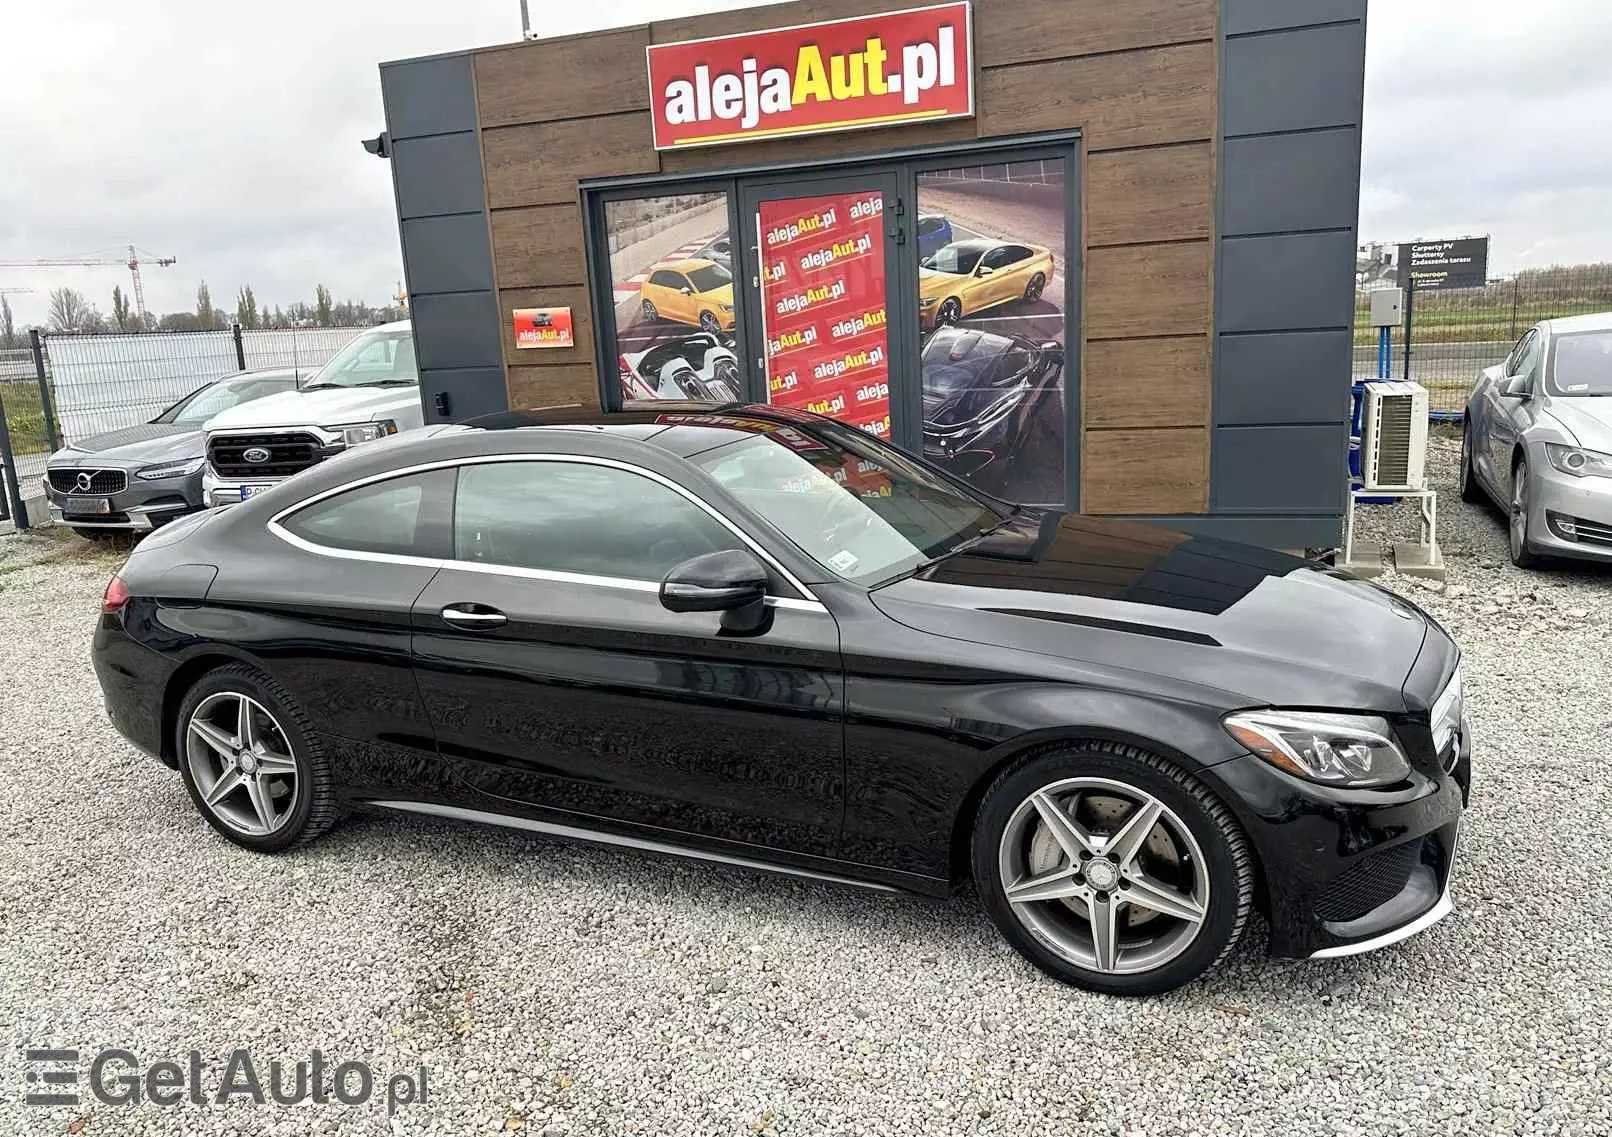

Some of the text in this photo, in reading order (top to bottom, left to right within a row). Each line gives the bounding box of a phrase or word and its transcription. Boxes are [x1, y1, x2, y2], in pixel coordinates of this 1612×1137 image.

[664, 25, 955, 128] alejaAut.pl
[850, 198, 883, 218] aleja
[767, 209, 836, 244] alejaAut.pl
[800, 234, 872, 269] alejaAut.pl
[1411, 271, 1448, 279] Showroom
[776, 280, 845, 314] alejaAut.pl
[814, 346, 883, 378] alejaAut.pl
[856, 383, 889, 400] aleja
